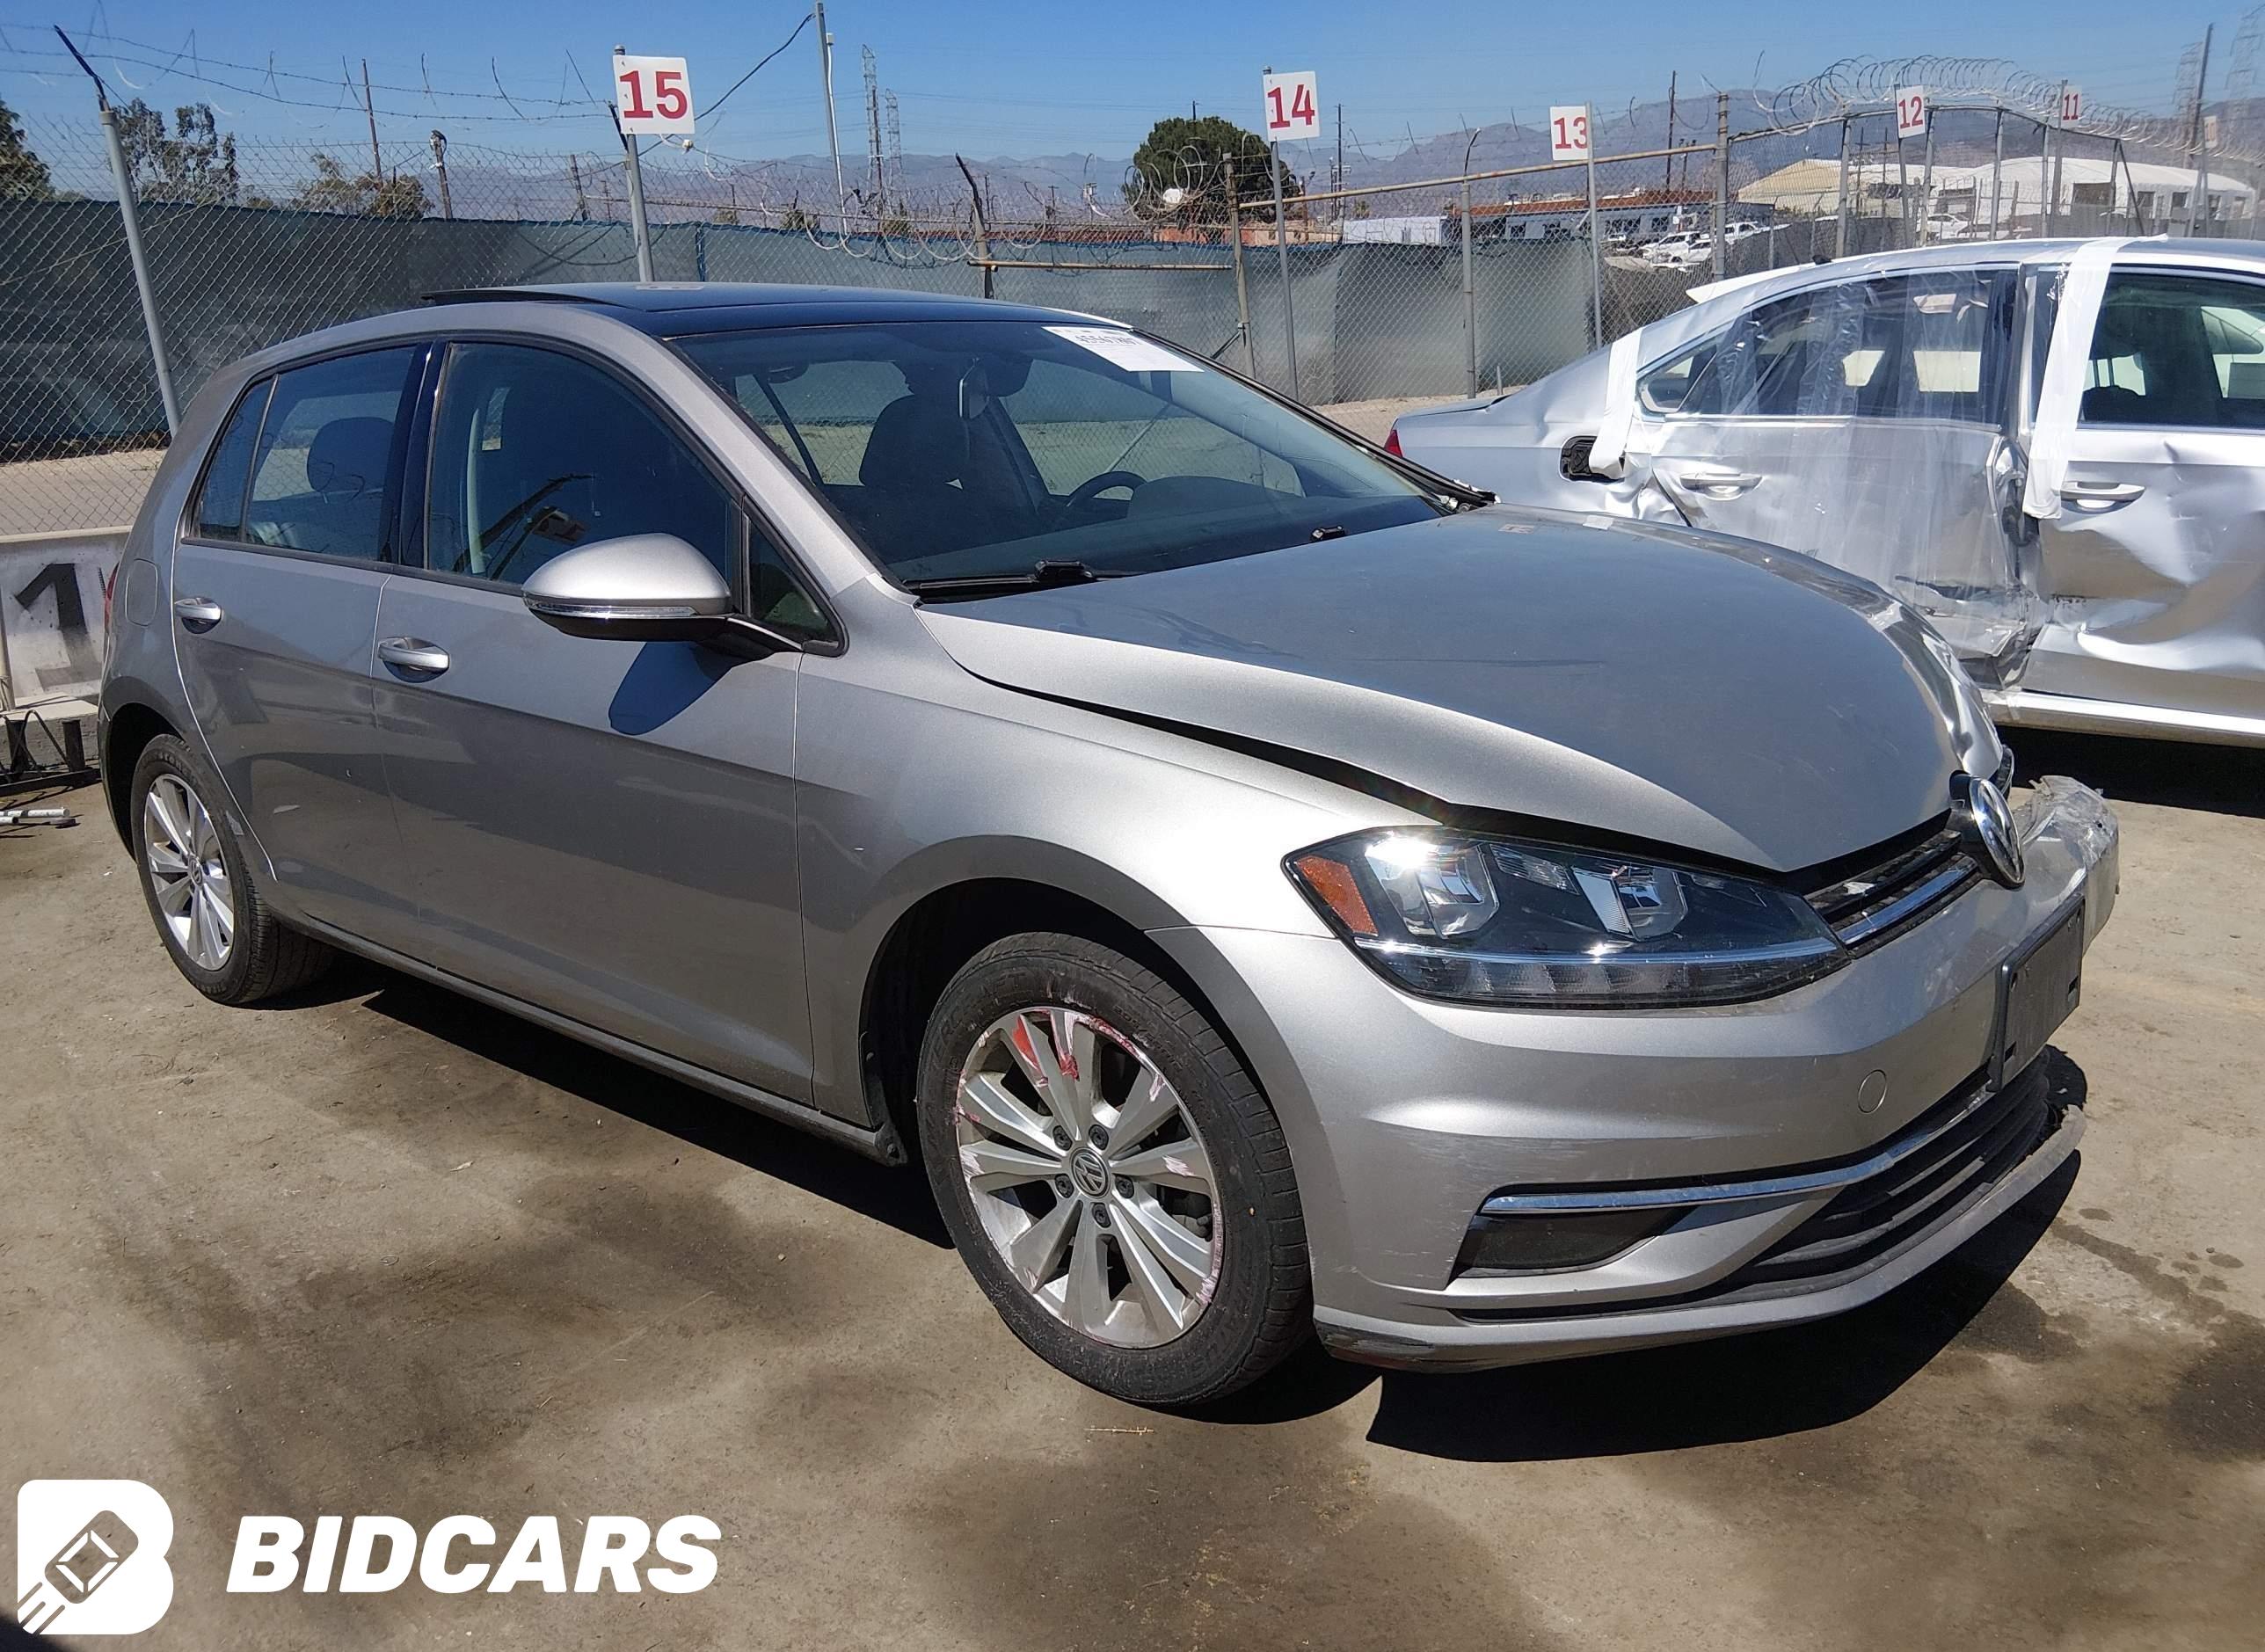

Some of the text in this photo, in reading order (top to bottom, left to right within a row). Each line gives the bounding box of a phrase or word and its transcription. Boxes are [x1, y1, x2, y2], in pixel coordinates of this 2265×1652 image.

[620, 70, 688, 120] 15
[1267, 84, 1315, 129] 14
[2063, 93, 2079, 120] 11
[1899, 96, 1924, 129] 12
[1554, 116, 1588, 149] 13
